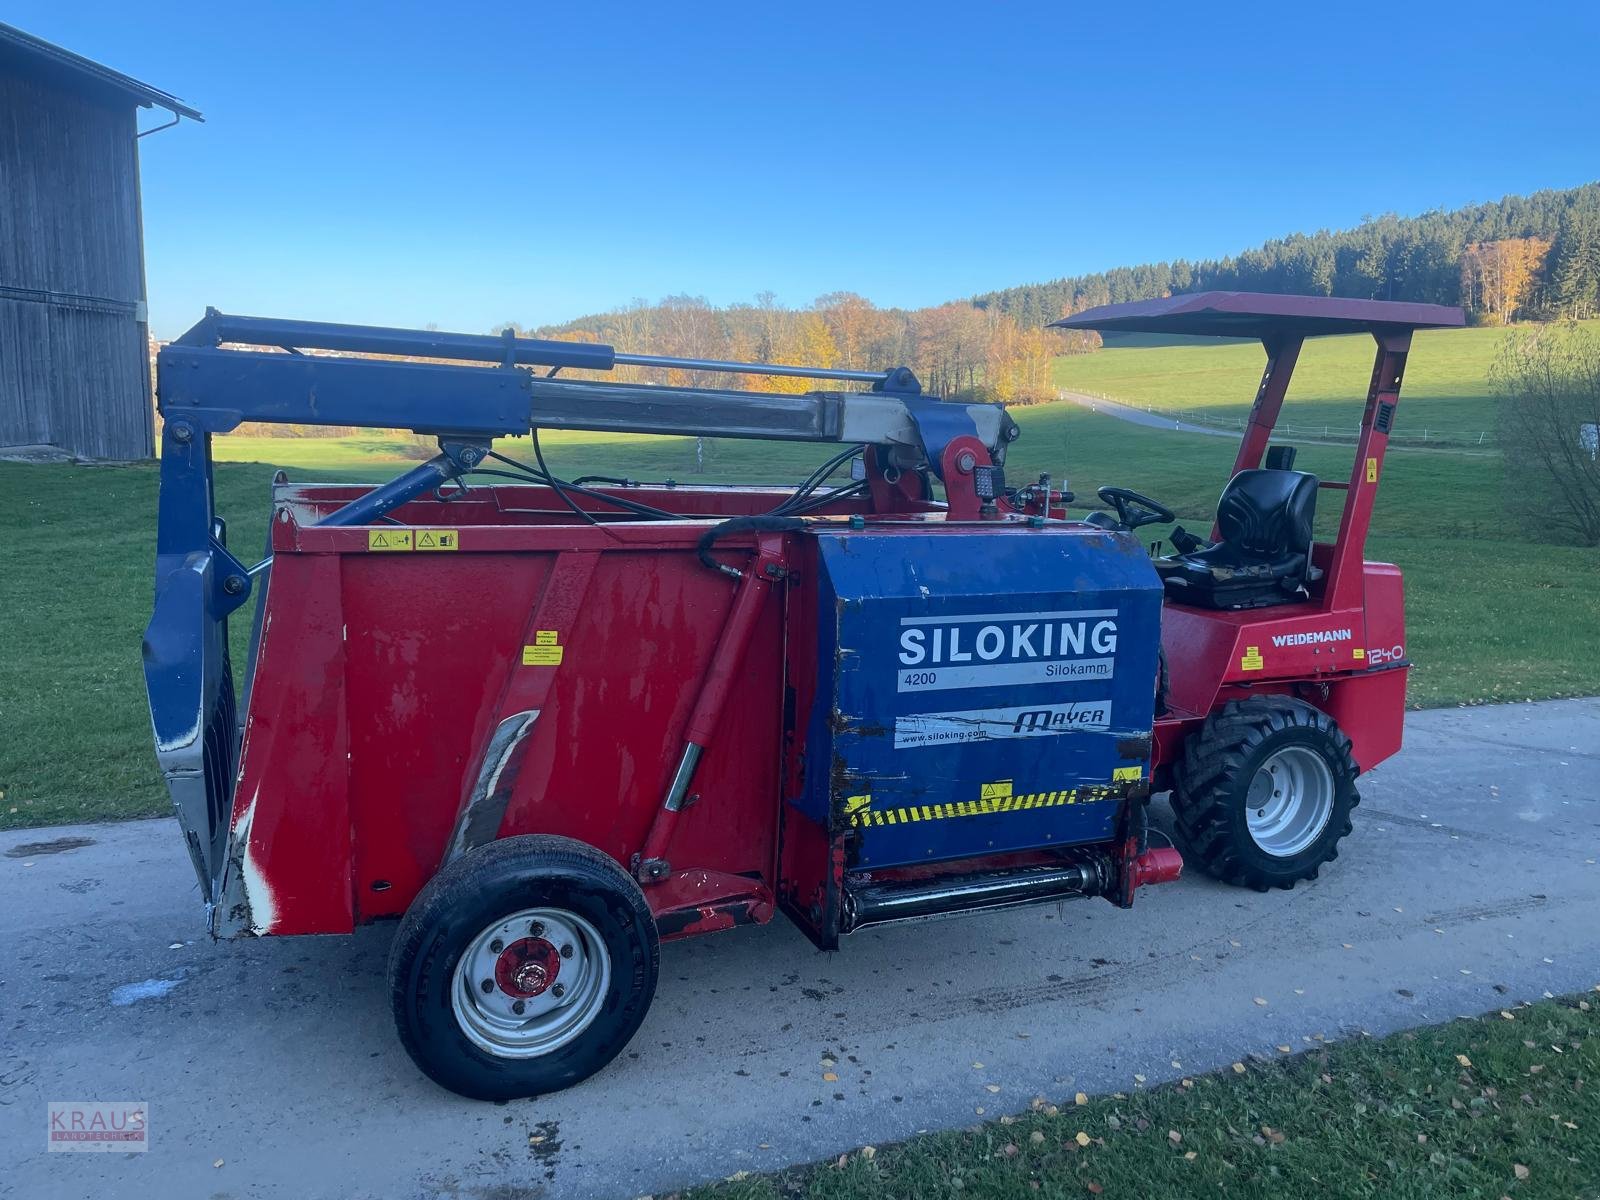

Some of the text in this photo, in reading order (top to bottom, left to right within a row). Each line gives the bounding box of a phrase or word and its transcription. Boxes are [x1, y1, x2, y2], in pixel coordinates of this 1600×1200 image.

[899, 620, 1117, 665] SILOKING
[1272, 629, 1352, 647] WEIDEMANN
[1366, 645, 1404, 665] 1240
[904, 672, 936, 686] 4200
[1046, 663, 1107, 677] Silokamm
[1013, 709, 1105, 733] MAYER
[902, 729, 987, 744] www.siloking.com
